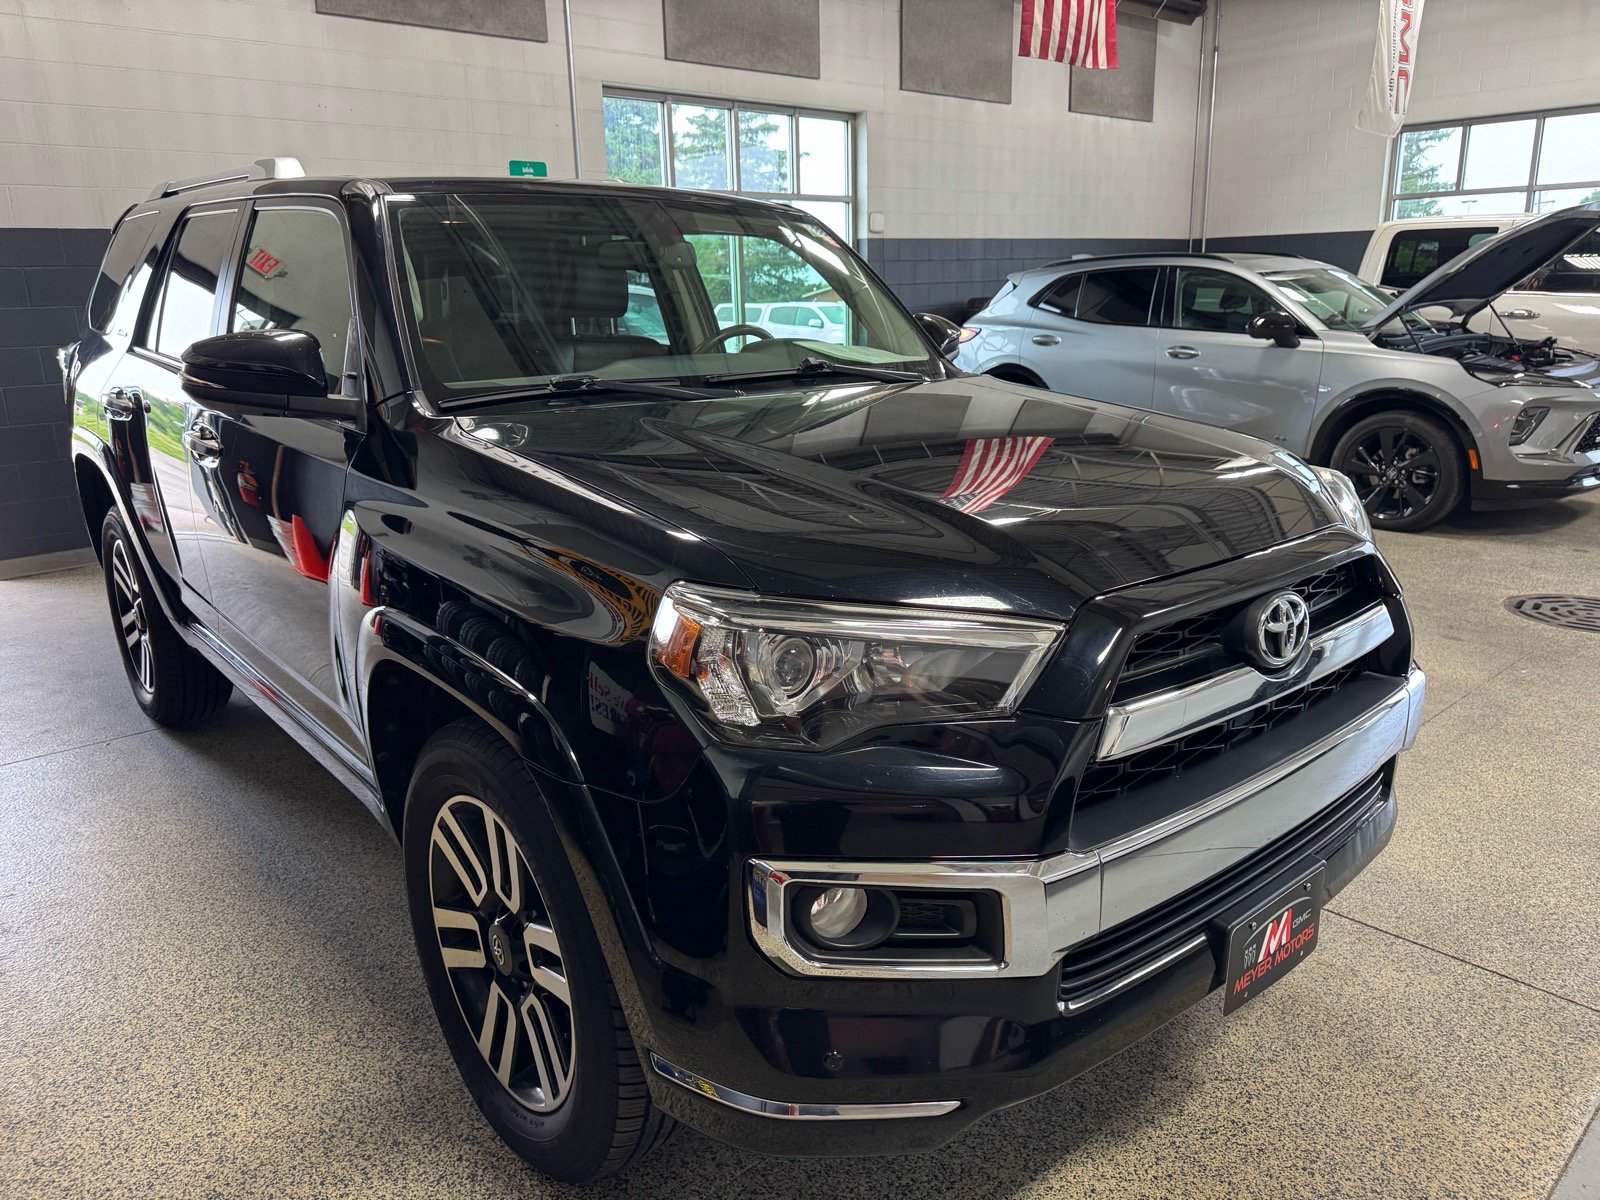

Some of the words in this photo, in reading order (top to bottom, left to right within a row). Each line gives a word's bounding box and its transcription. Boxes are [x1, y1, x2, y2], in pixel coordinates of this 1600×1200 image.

[1292, 908, 1311, 929] GMC
[1233, 956, 1273, 995] MEYER
[1274, 924, 1315, 966] MOTORS
